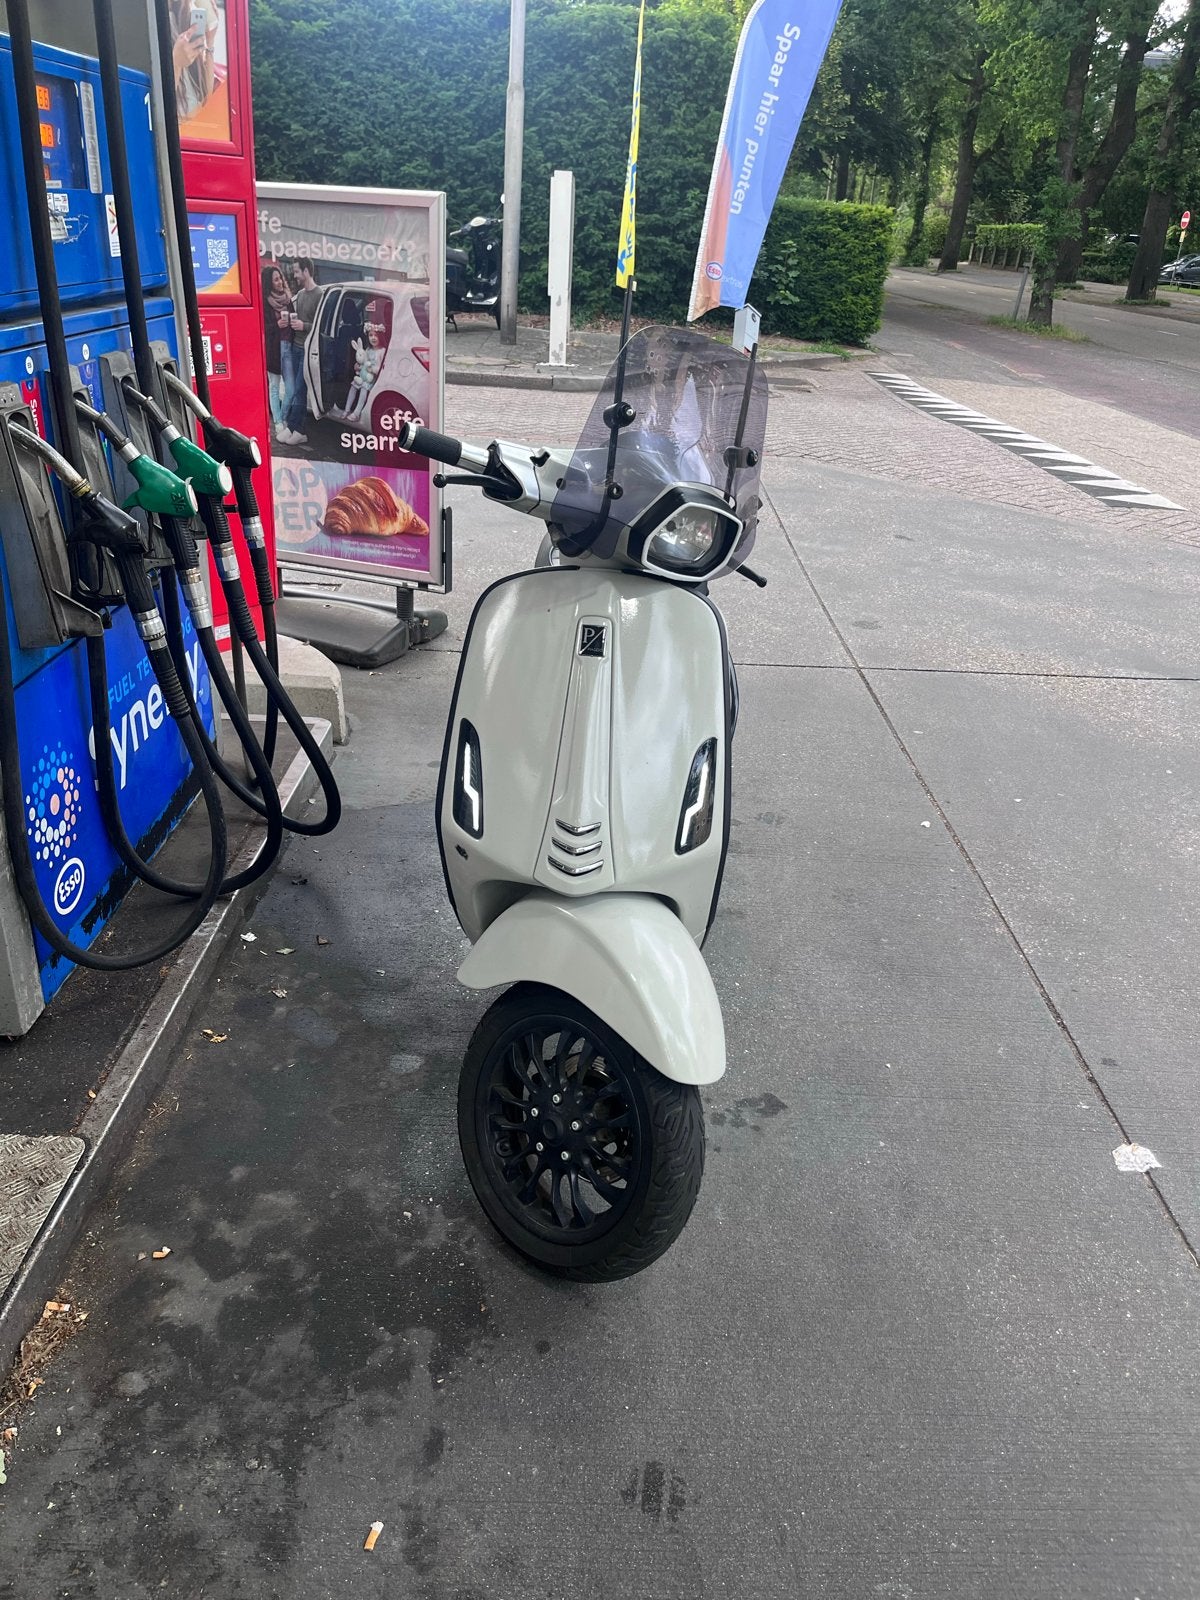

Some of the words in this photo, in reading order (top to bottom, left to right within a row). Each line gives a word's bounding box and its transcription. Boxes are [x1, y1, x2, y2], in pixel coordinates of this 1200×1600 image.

[768, 22, 801, 88] Spaar
[145, 93, 153, 131] 1
[754, 92, 779, 136] hier
[730, 138, 759, 215] punten
[257, 210, 282, 233] fe
[271, 236, 418, 262] paasbezoek?
[108, 672, 136, 710] FUEL
